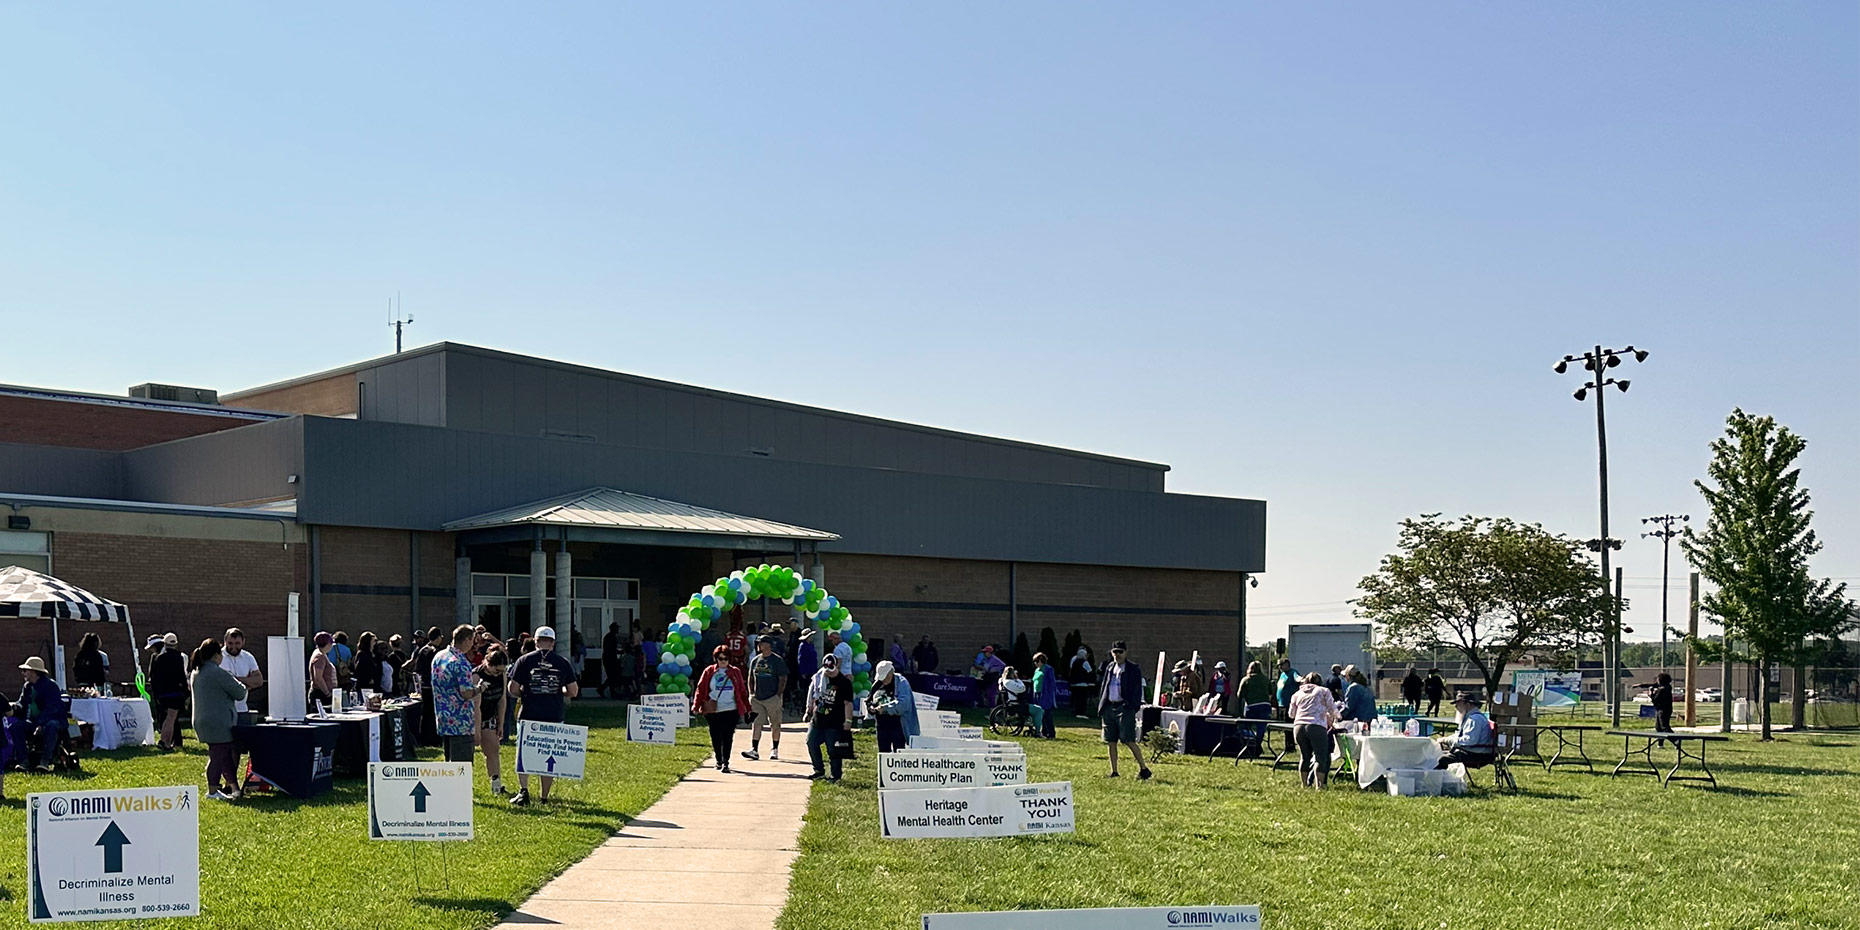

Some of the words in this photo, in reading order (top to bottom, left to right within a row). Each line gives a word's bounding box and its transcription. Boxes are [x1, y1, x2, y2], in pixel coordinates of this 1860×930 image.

[729, 639, 741, 651] 15
[523, 740, 536, 748] Find
[537, 742, 553, 750] Help.
[554, 743, 567, 751] Find
[568, 745, 585, 753] Hope.
[526, 735, 555, 744] Education
[563, 739, 583, 747] Power.
[886, 758, 919, 769] United
[921, 758, 976, 770] Healthcare
[889, 771, 947, 785] Community
[950, 772, 973, 783] Plan
[925, 799, 968, 812] Heritage
[1019, 797, 1068, 809] THANK
[1027, 808, 1061, 819] YOU!
[382, 820, 425, 828] Decriminalize
[426, 820, 448, 828] Mental
[449, 820, 471, 828] Illness
[897, 816, 930, 827] Mental
[932, 815, 966, 826] Health
[968, 814, 1004, 825] Center
[58, 877, 134, 890] Decriminalize
[137, 874, 175, 886] Mental
[99, 892, 135, 902] Illness
[57, 906, 137, 916] www.namikansas.org
[141, 903, 190, 913] 800-539-2660
